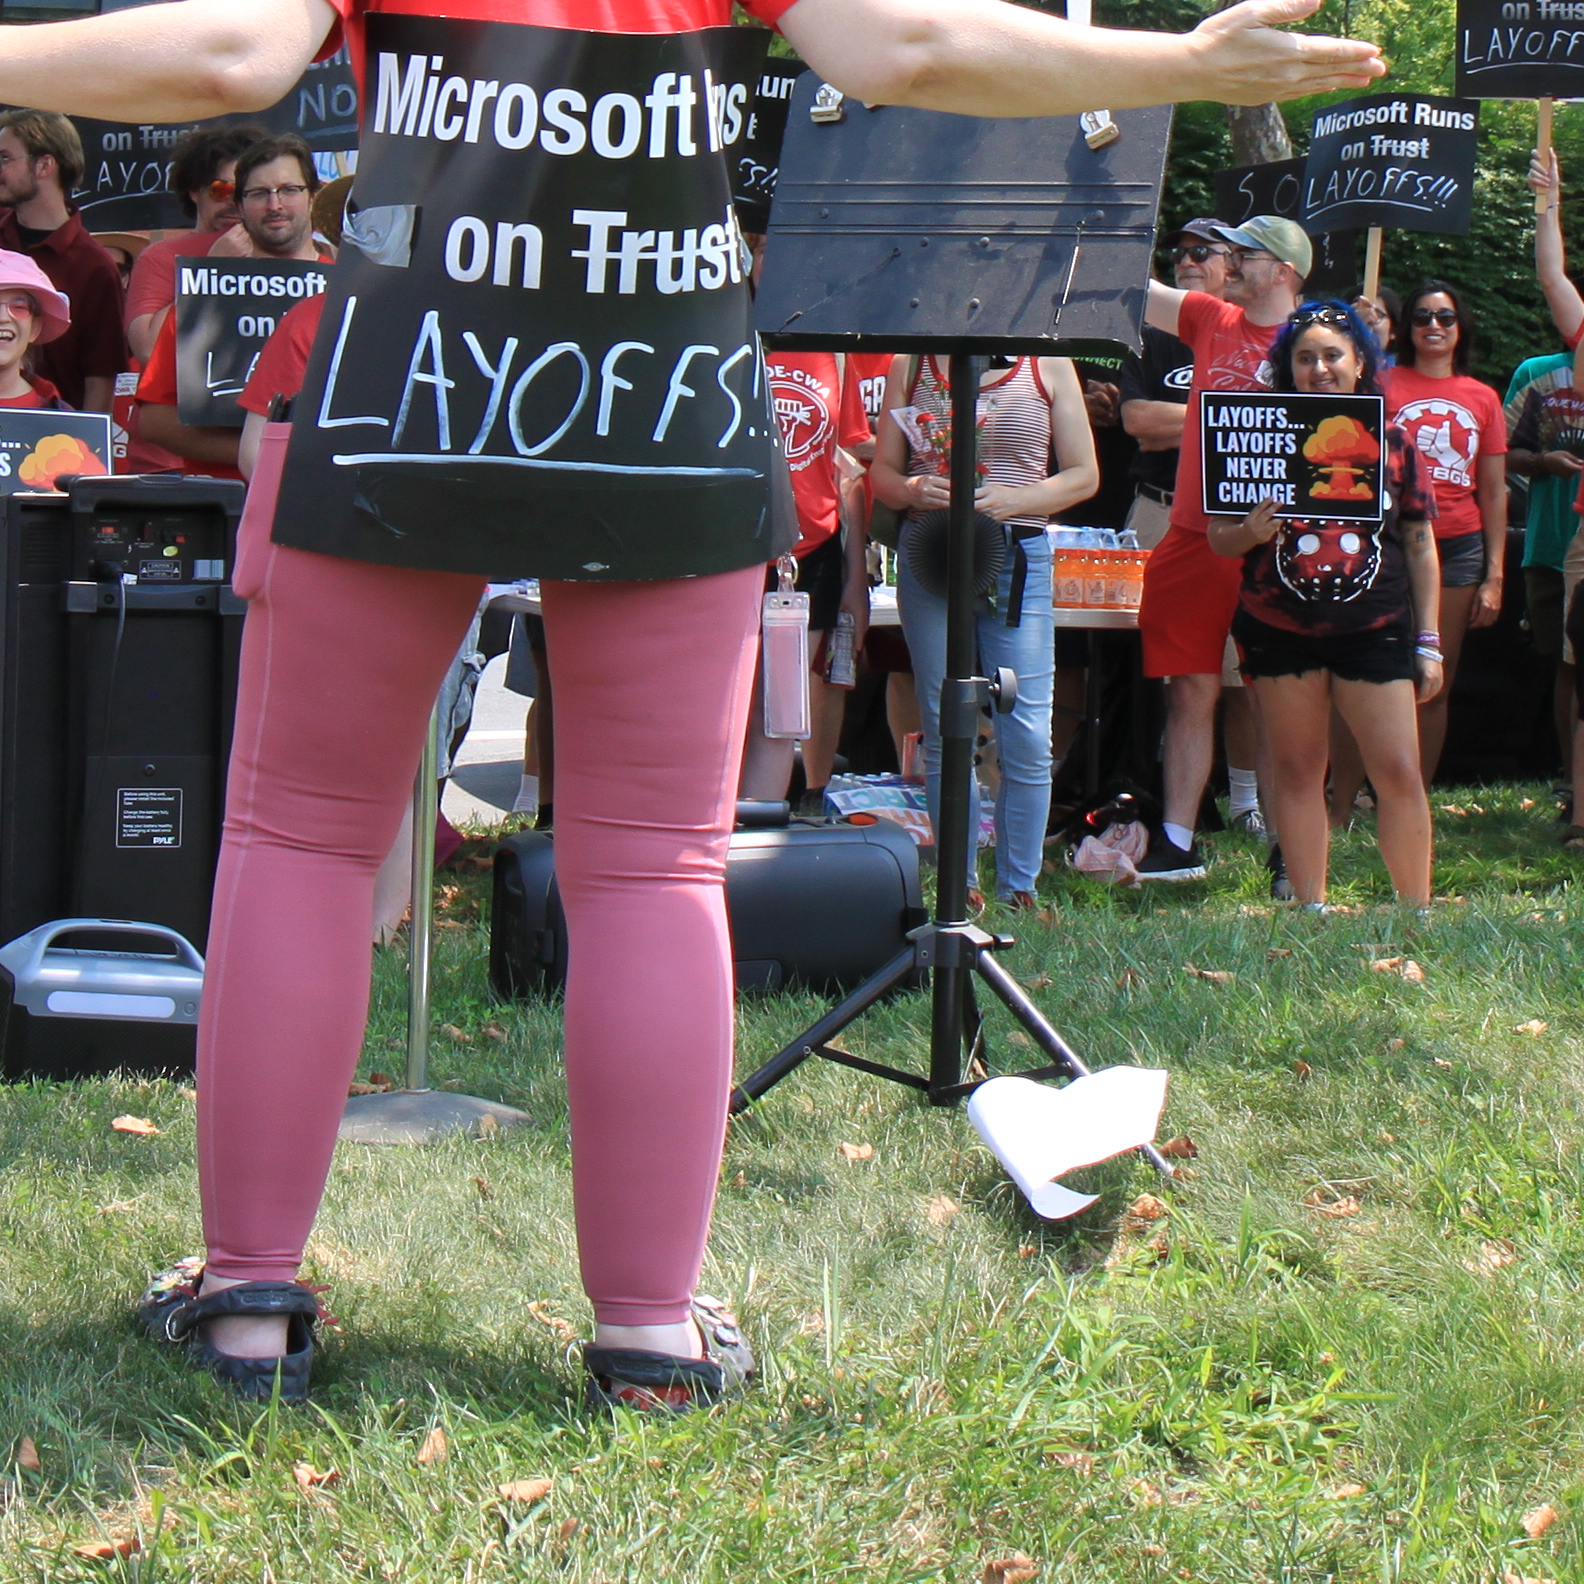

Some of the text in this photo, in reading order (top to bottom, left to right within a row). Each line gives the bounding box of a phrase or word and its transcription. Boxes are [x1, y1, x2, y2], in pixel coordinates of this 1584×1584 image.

[1501, 2, 1530, 21] on
[373, 51, 697, 159] Microsoft
[1314, 100, 1475, 139] Microsoft Runs
[102, 131, 132, 151] on
[1340, 134, 1430, 161] on Trust
[445, 204, 742, 296] on Trust
[180, 267, 327, 298] Microsoft
[237, 314, 276, 337] on
[1207, 406, 1305, 430] LAYOFFS...
[1216, 431, 1297, 455] LAYOFFS
[1226, 457, 1287, 479] NEVER
[1218, 481, 1296, 505] CHANGE
